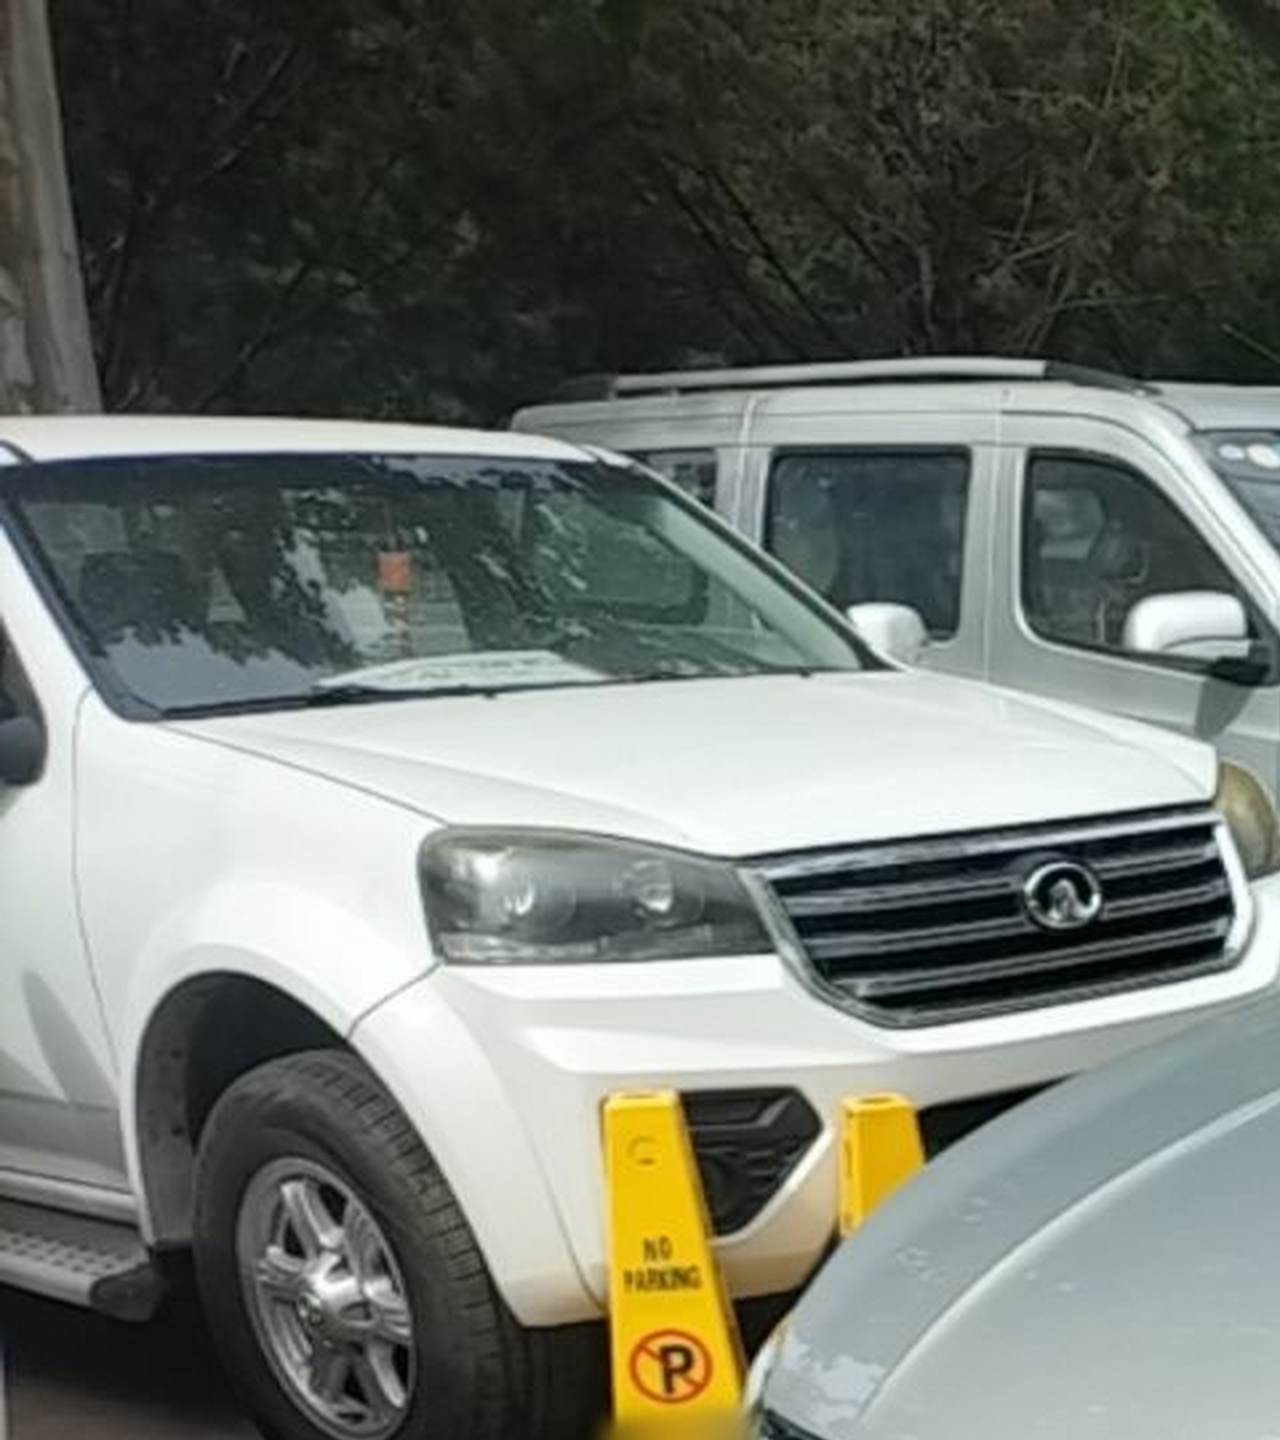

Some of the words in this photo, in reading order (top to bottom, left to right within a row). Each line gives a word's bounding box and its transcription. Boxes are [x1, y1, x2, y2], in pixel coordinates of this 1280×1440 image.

[643, 1236, 673, 1262] NO
[623, 1266, 702, 1293] PARKING
[658, 1344, 695, 1395] P
